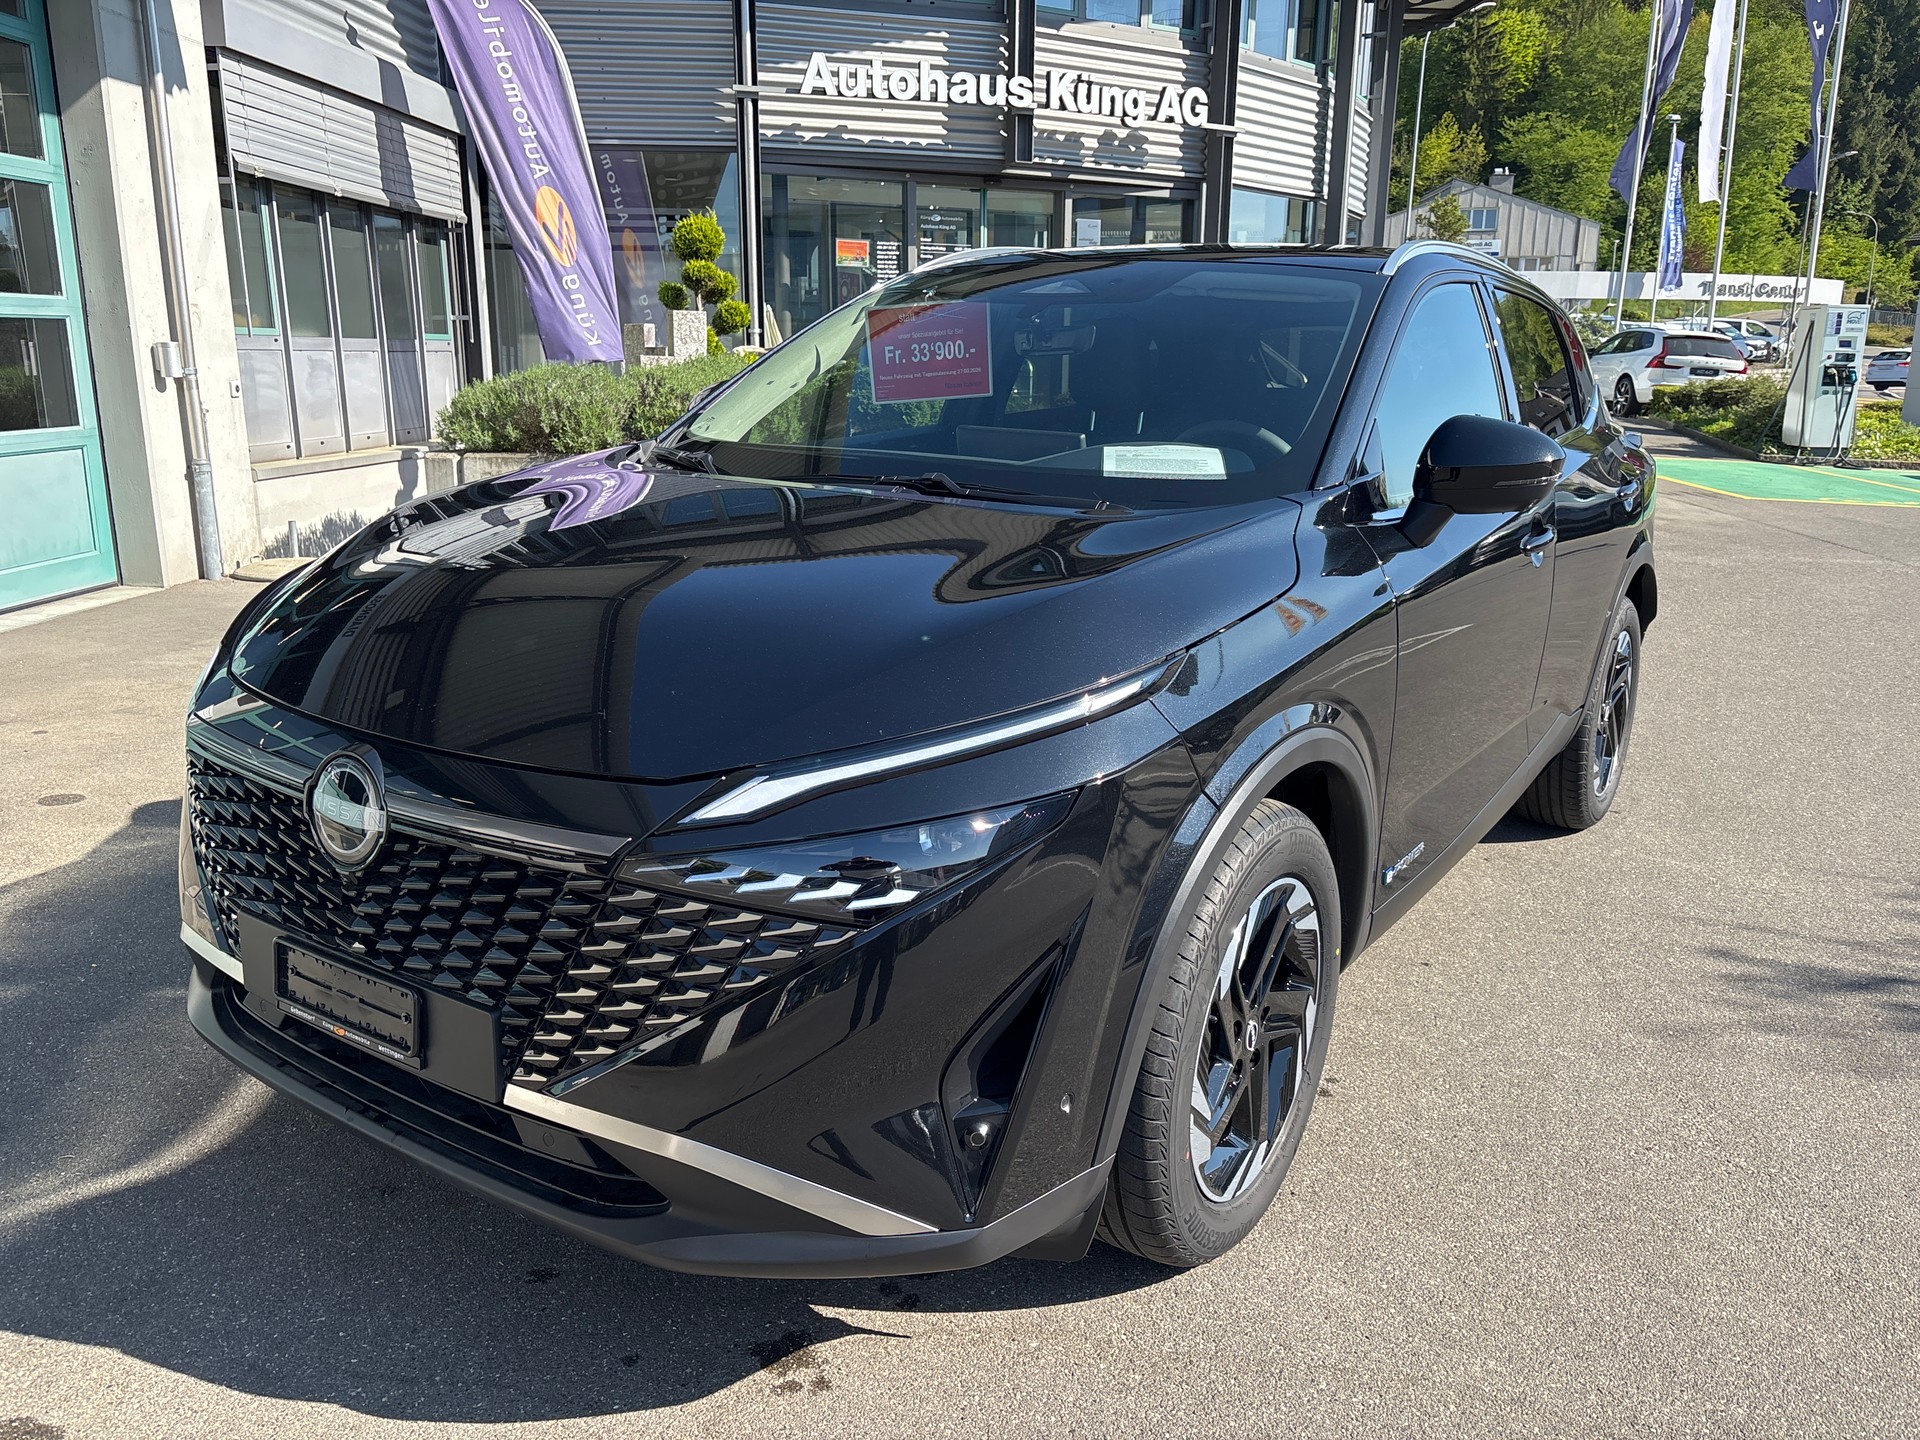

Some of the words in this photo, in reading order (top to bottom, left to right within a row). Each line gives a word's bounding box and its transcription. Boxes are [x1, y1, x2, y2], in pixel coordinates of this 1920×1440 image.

[800, 51, 1033, 108] Autohaus
[1046, 69, 1147, 127] Küng
[1156, 85, 1209, 128] AG
[1667, 161, 1682, 210] Center
[1667, 212, 1676, 264] Transit
[1698, 280, 1754, 297] Tansit
[884, 345, 906, 365] Fr.
[315, 793, 385, 829] NISSAN
